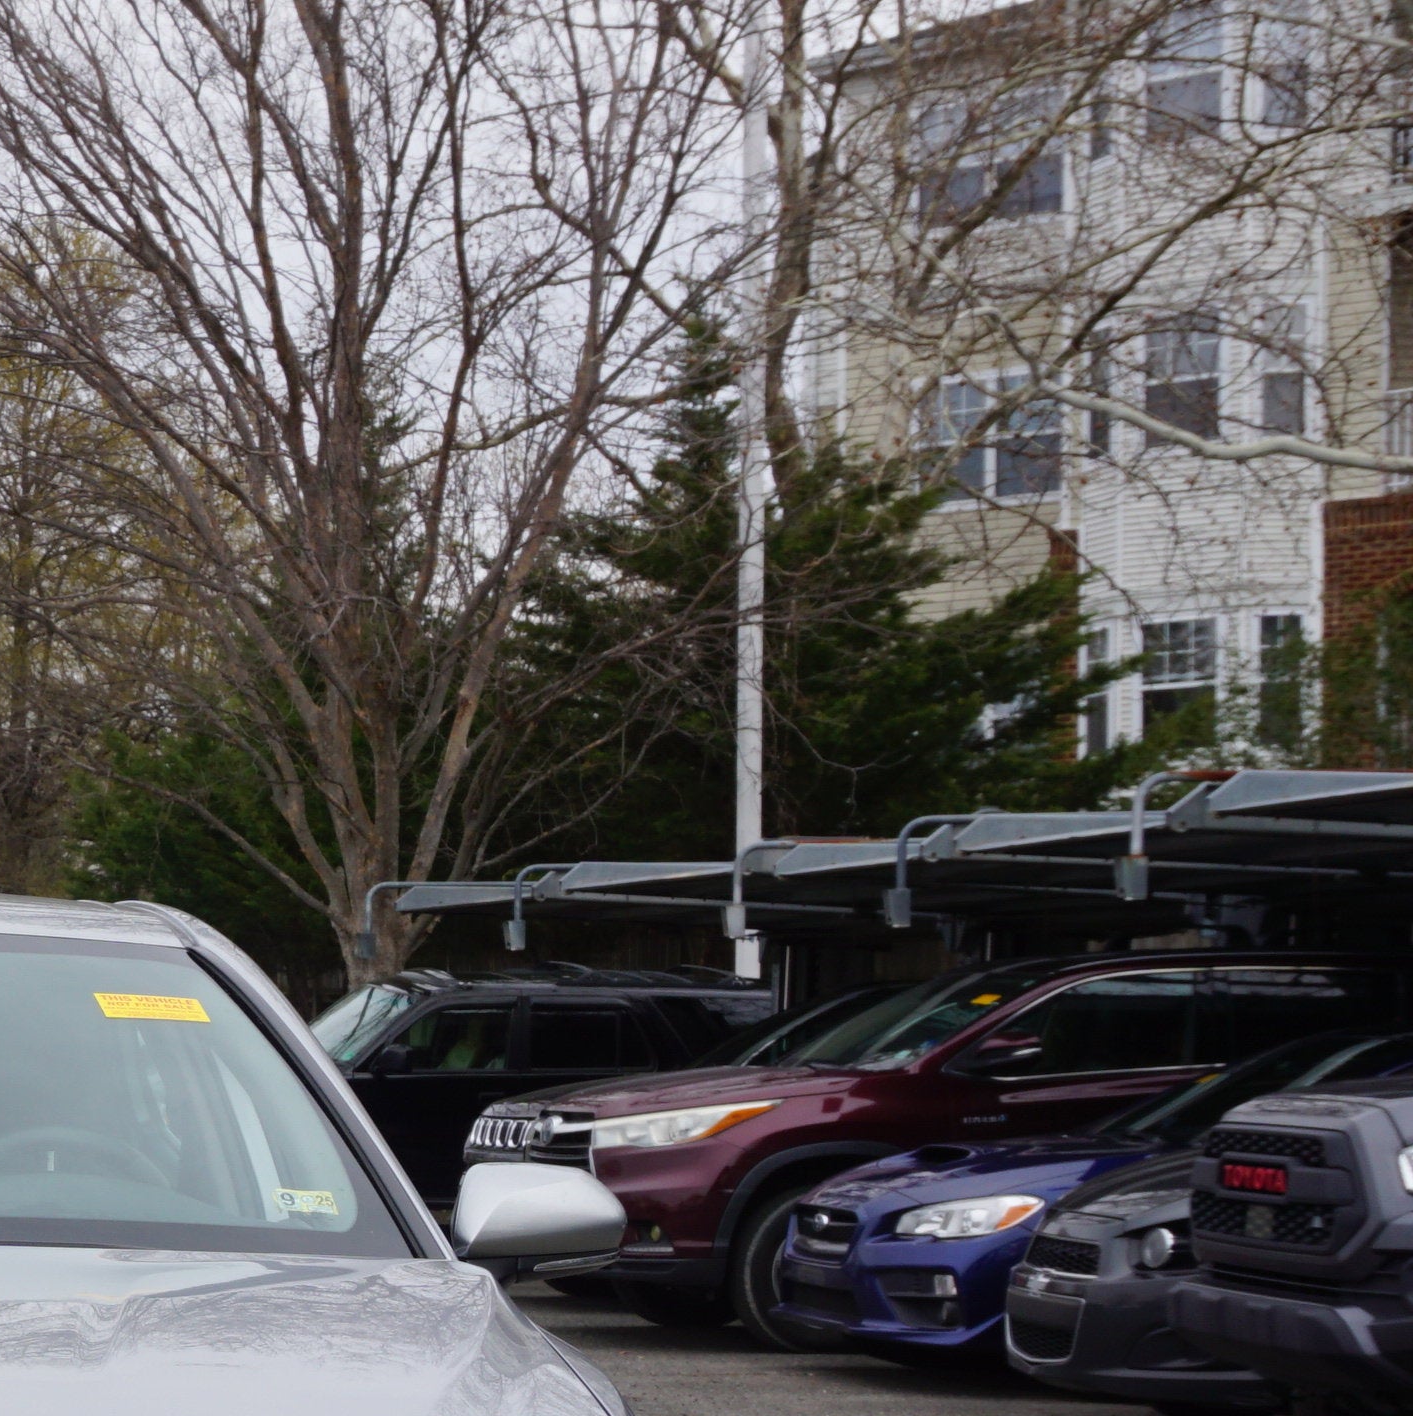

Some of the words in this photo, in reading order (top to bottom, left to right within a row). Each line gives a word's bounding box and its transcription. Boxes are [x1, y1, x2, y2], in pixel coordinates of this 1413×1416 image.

[99, 994, 132, 1002] THIS
[134, 995, 194, 1005] VEHICLE
[1223, 1164, 1287, 1193] TOYOTA
[280, 1192, 295, 1206] 9
[315, 1194, 334, 1207] 25
